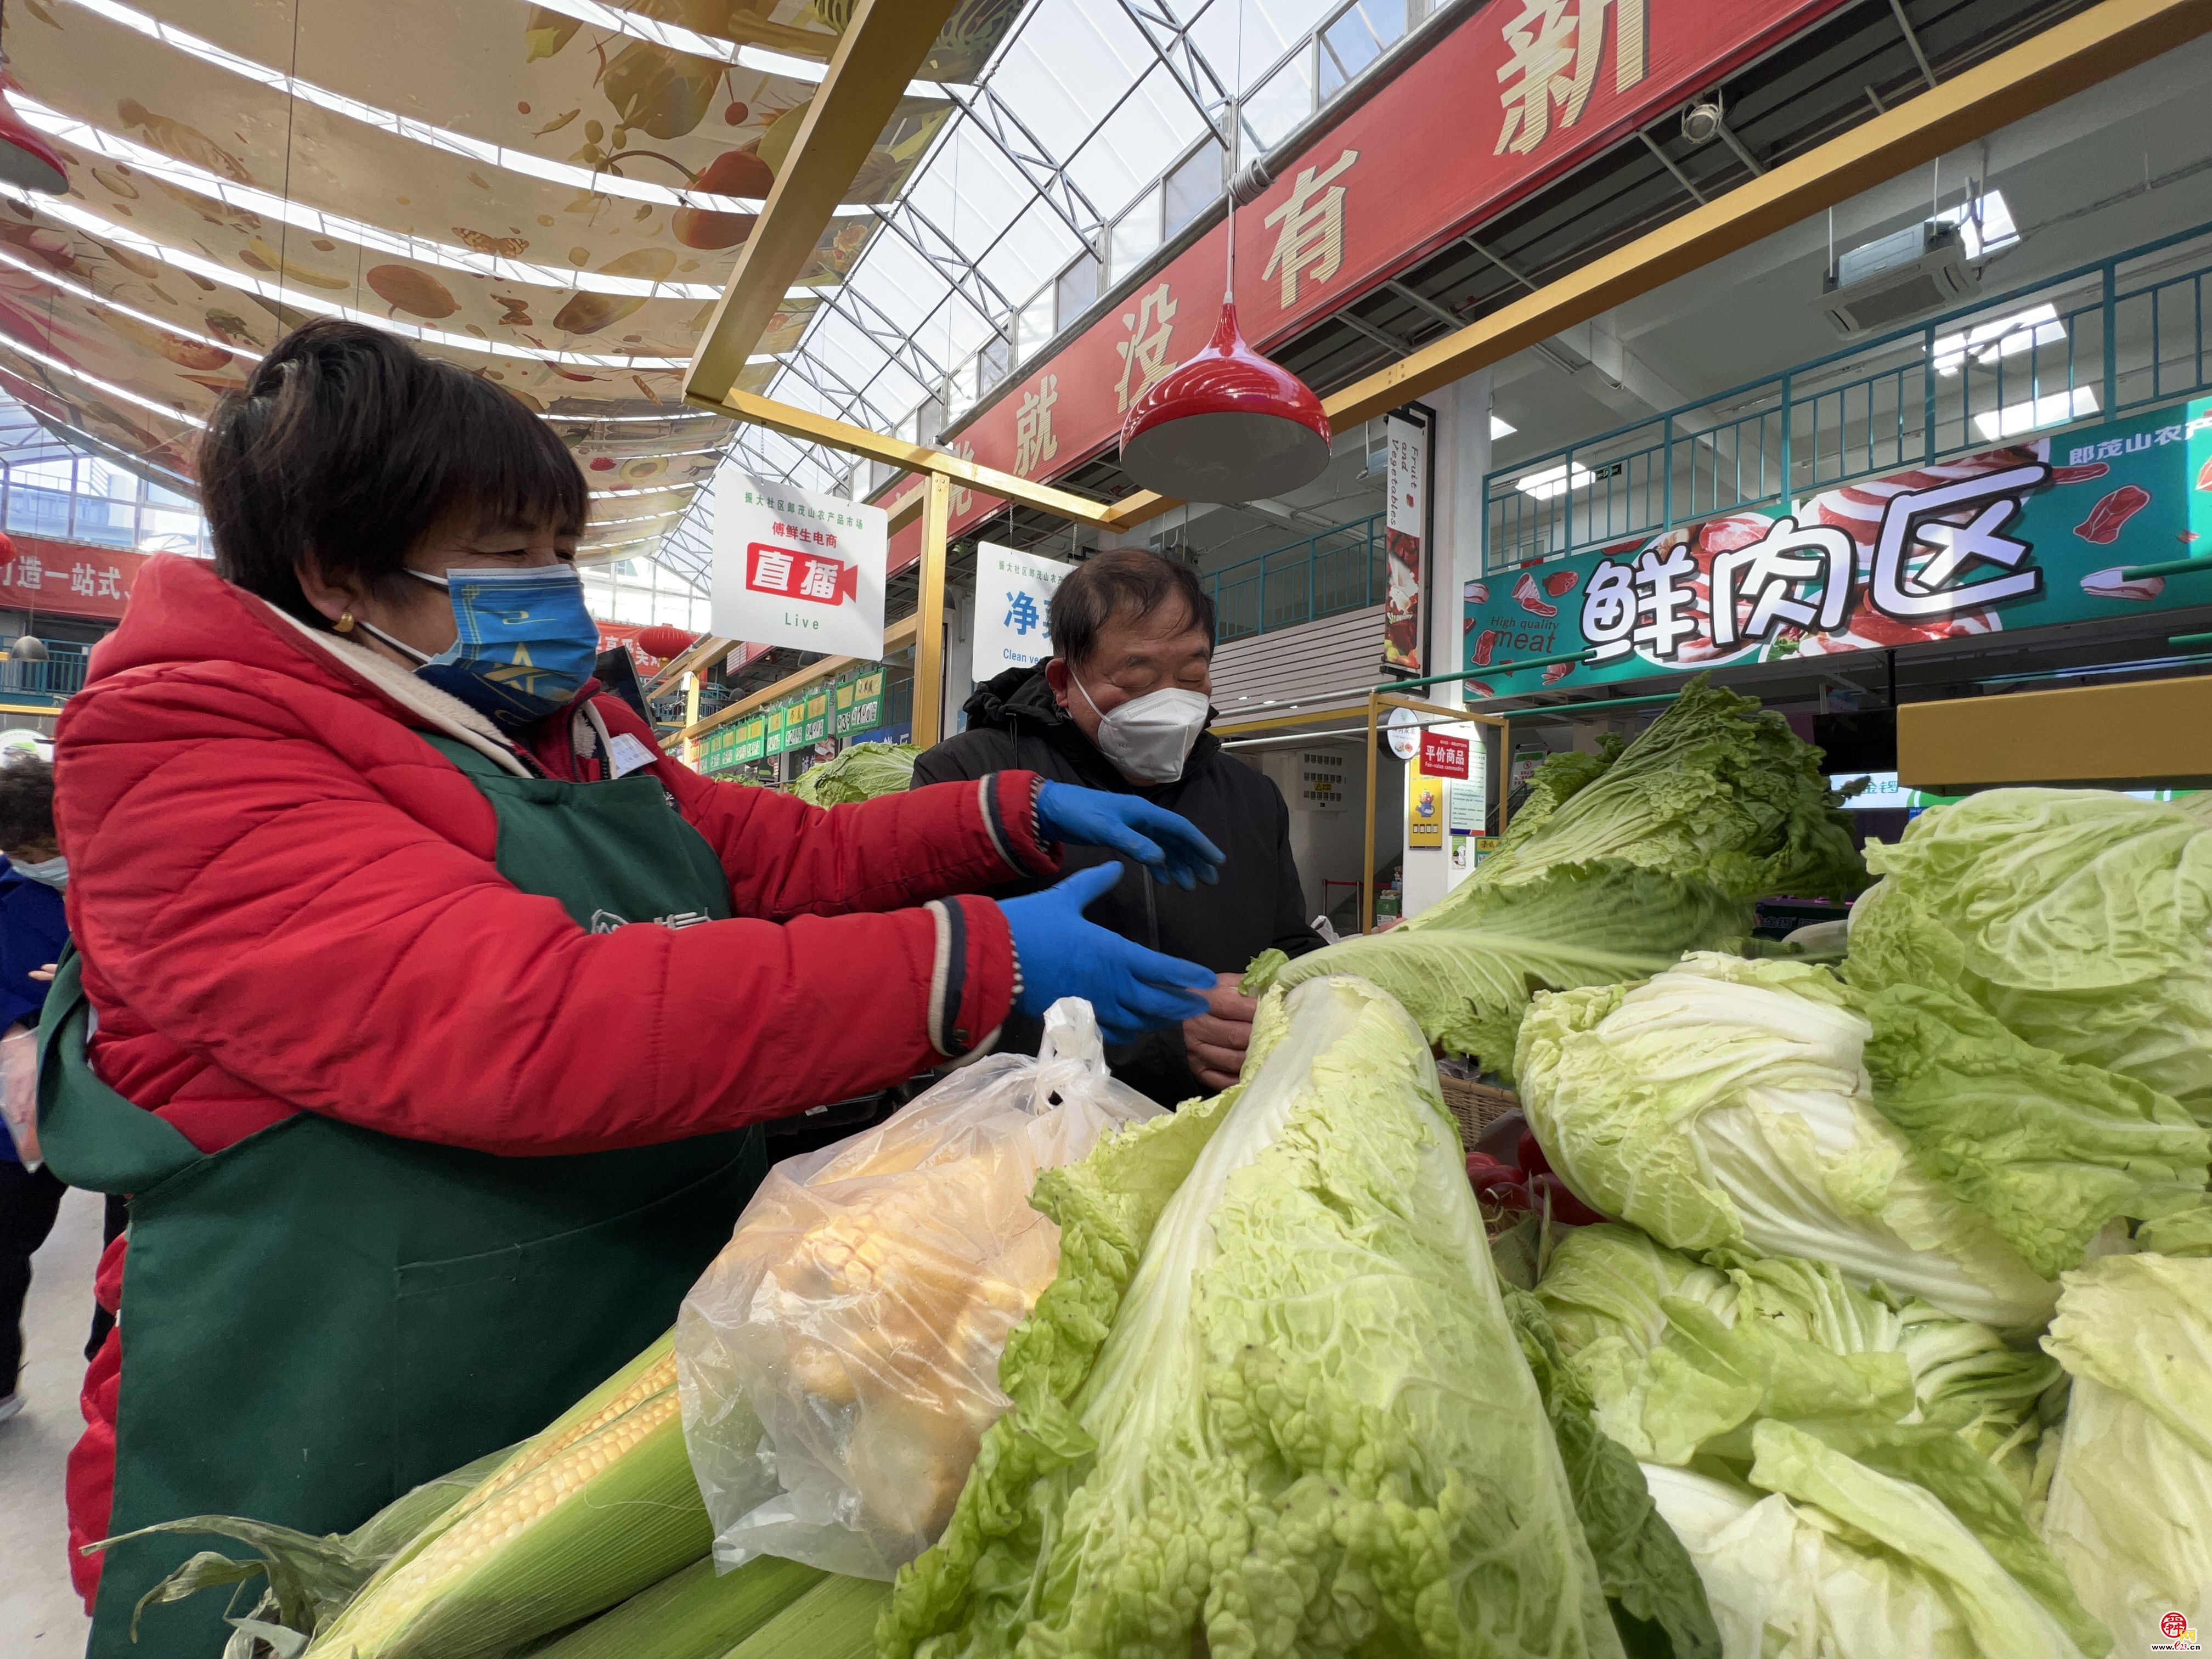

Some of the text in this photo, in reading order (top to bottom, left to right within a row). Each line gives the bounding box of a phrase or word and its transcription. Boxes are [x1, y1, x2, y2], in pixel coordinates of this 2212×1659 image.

[1390, 439, 1399, 526] Vegetables
[744, 491, 864, 530] 振大社区郎茂山农产品市场
[771, 521, 838, 549] 傅鲜生电商
[752, 550, 839, 599] 直播
[1582, 462, 2052, 665] 鲜肉区
[785, 612, 820, 630] Live
[1491, 616, 1559, 631] High quality
[1493, 629, 1556, 653] meat
[1003, 648, 1027, 663] Clean
[1425, 745, 1465, 765] 平价商品
